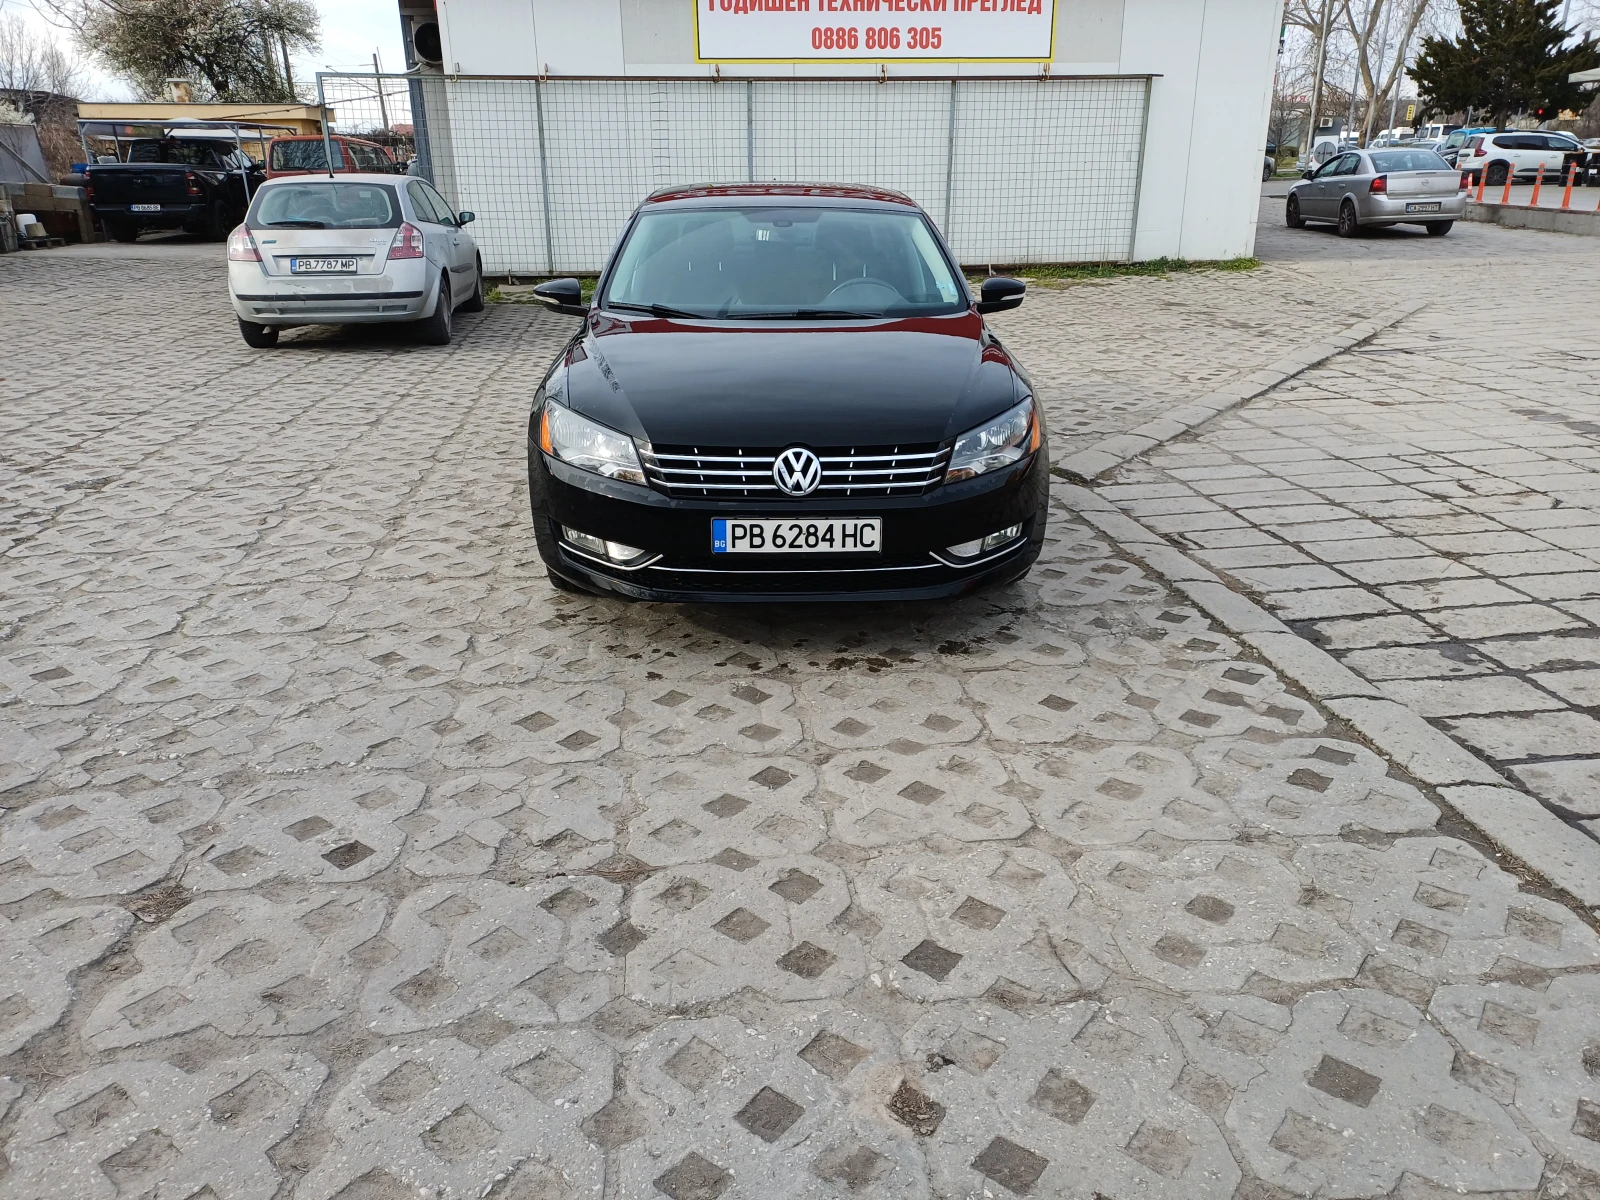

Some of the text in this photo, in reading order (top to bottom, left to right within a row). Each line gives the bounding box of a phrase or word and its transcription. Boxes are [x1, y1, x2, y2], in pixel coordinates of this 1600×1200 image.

[811, 27, 942, 50] 0886 806 305
[298, 260, 355, 270] PB 7787 MP
[714, 540, 726, 548] BG
[731, 523, 876, 549] PB 6284 HC
